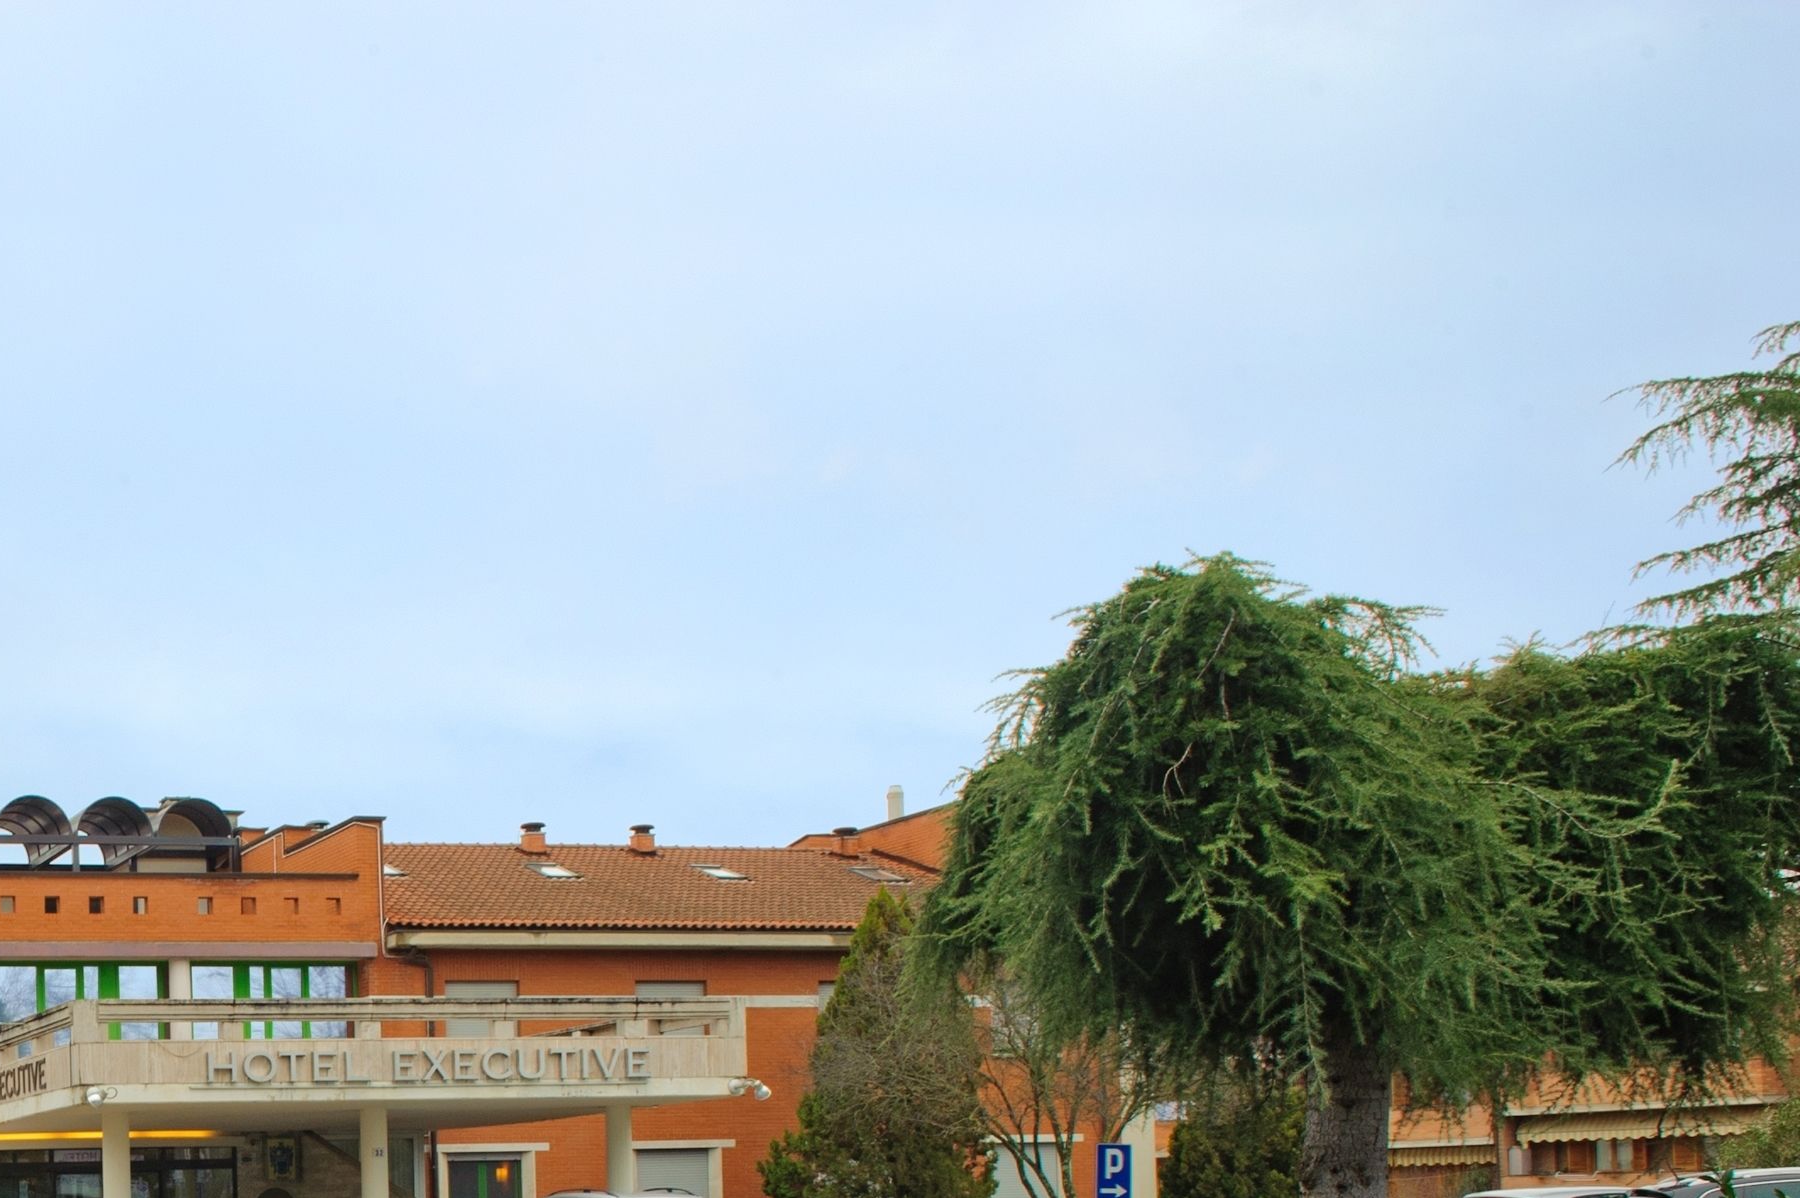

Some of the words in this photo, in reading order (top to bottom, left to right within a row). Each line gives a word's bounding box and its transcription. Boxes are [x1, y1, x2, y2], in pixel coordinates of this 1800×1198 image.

[206, 1050, 371, 1083] HOTEL
[393, 1046, 651, 1082] EXECUTIVE
[1104, 1148, 1124, 1179] P
